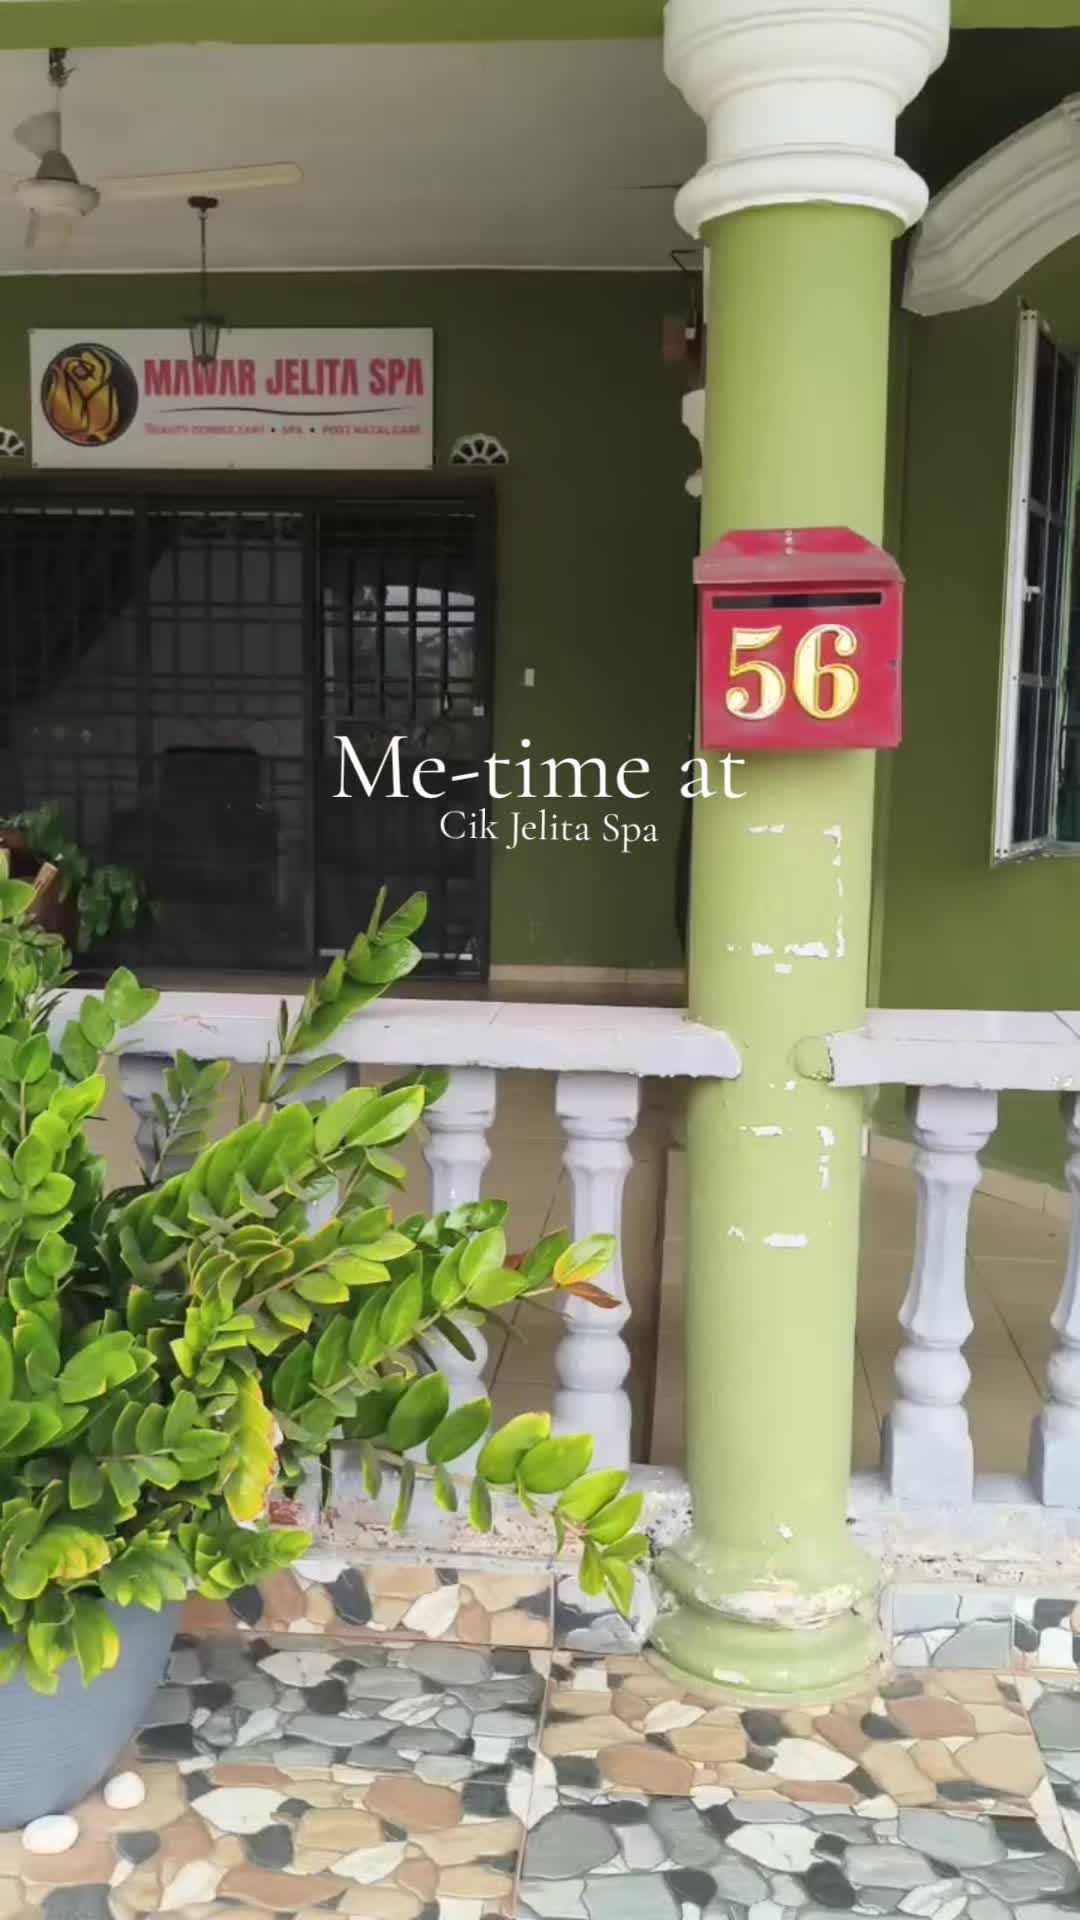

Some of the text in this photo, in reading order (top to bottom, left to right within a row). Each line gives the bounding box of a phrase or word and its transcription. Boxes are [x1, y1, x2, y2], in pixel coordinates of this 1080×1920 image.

[143, 358, 424, 396] MAWAR JELITA SPA
[725, 624, 859, 720] 56
